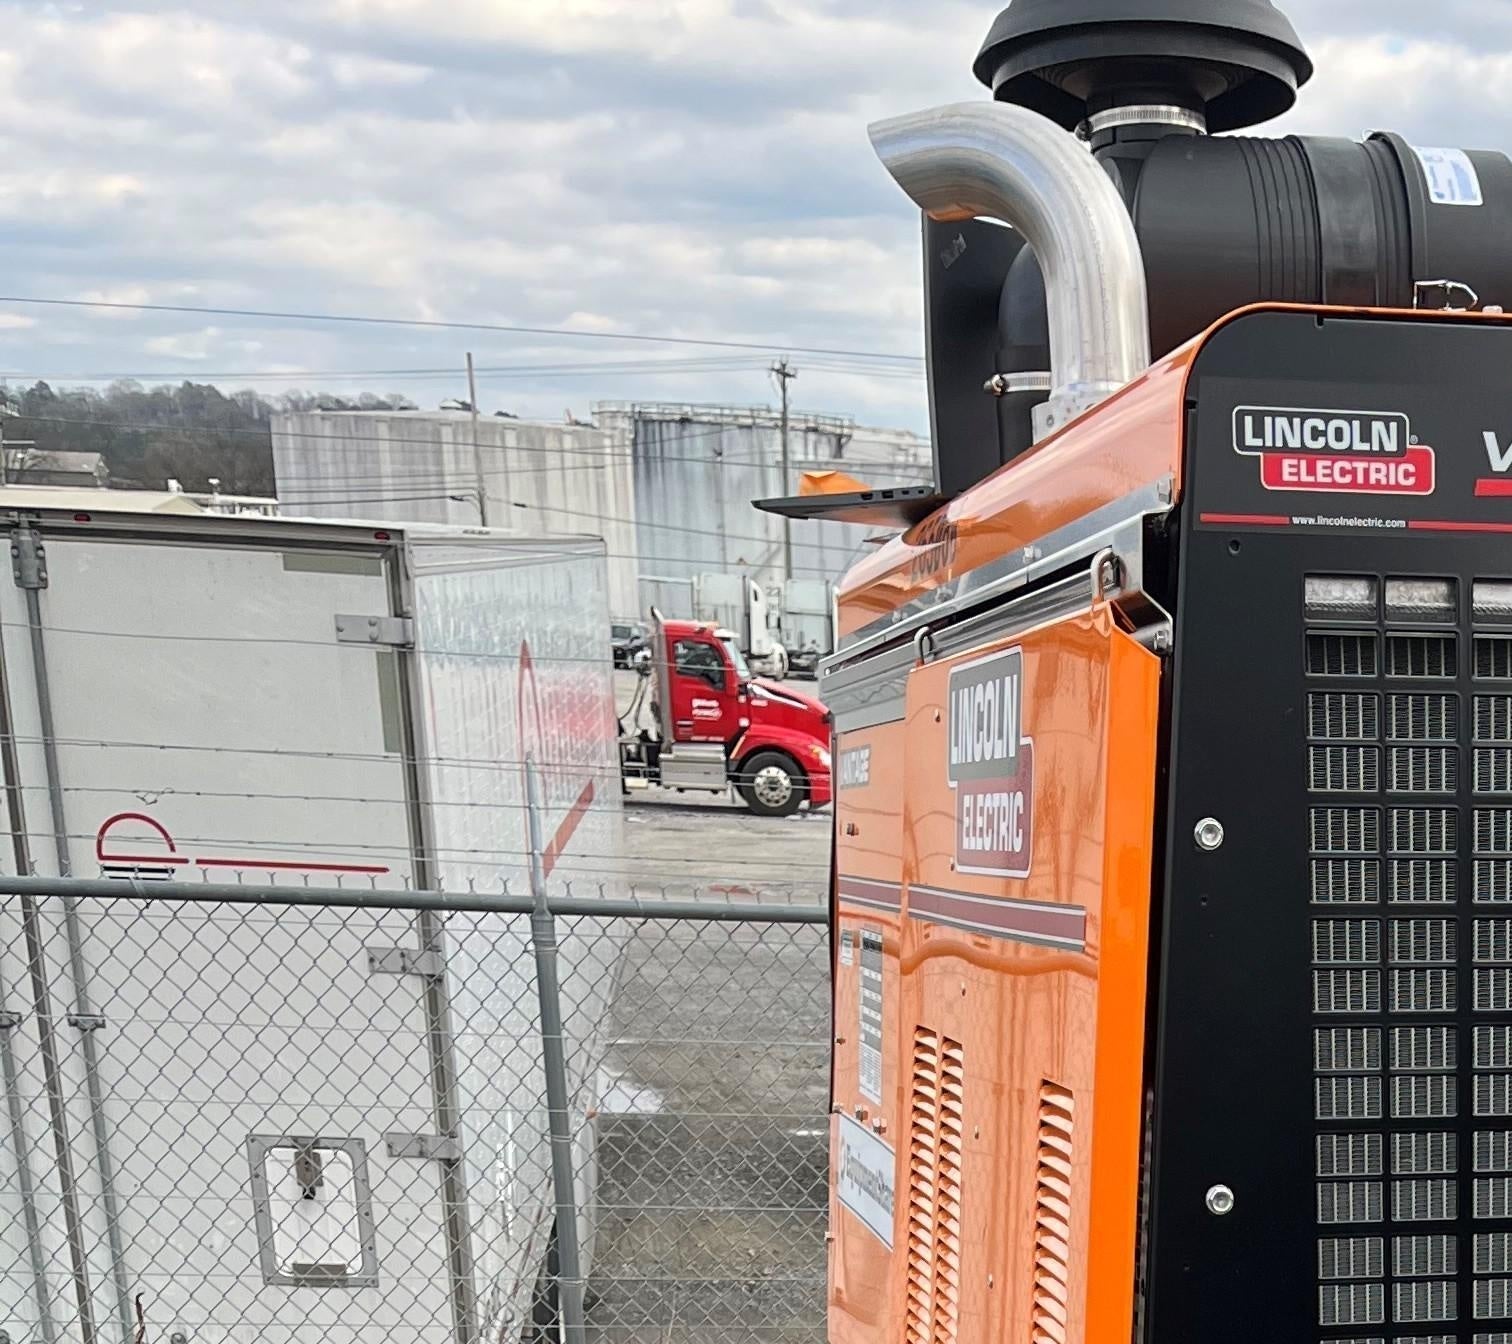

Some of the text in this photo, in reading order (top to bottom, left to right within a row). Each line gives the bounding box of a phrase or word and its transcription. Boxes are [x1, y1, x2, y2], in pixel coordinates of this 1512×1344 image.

[1244, 415, 1398, 452] LINCOLN
[1281, 458, 1416, 486] ELECTRIC
[1292, 515, 1406, 529] www.lincolnelectric.com
[951, 674, 1018, 764] LINCOLN
[963, 791, 1024, 852] ELECTRIC
